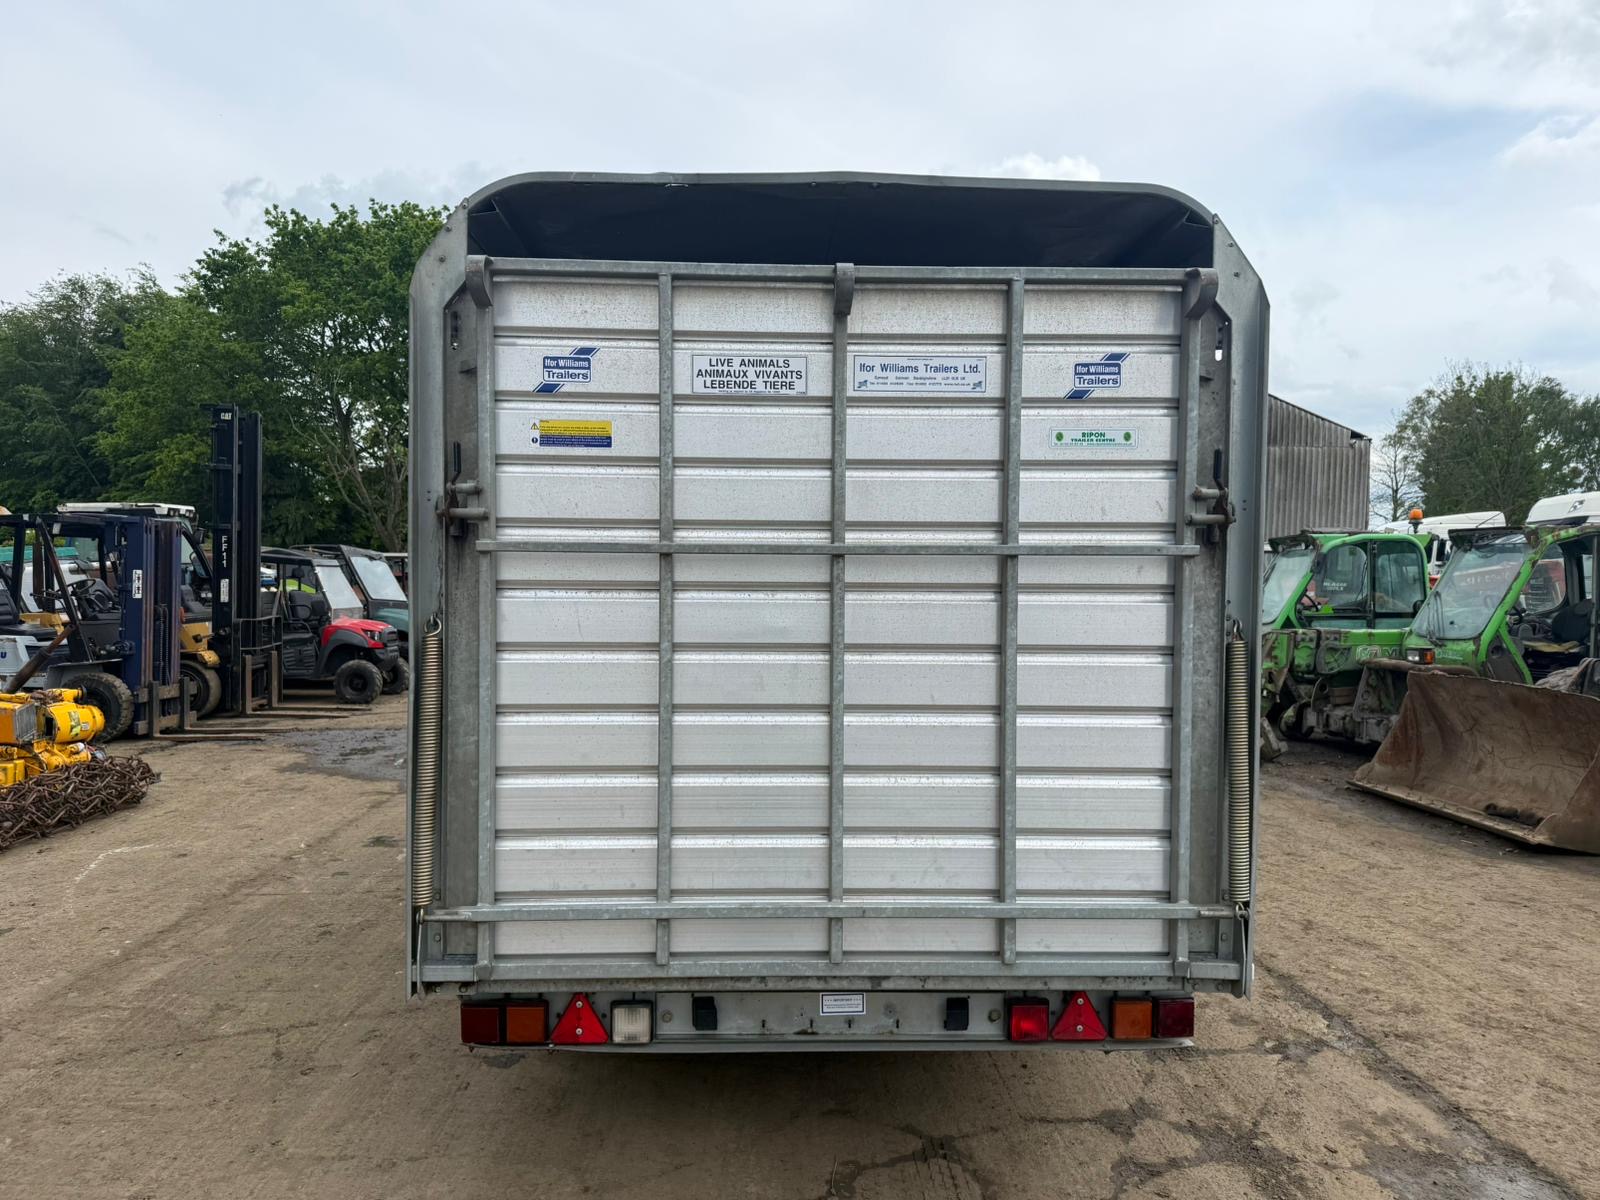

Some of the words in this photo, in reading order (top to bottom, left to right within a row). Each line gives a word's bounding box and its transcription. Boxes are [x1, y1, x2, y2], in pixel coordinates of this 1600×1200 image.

[545, 358, 557, 367] Ifor
[558, 359, 589, 367] Williams
[709, 358, 734, 367] LIVE
[739, 358, 790, 368] ANIMALS
[860, 363, 875, 372] Ifor
[880, 363, 919, 373] Williams
[923, 364, 958, 373] Trailers
[963, 364, 981, 374] Ltd.
[1076, 365, 1088, 373] Ifor
[1089, 365, 1118, 373] Williams
[545, 370, 589, 380] Trailers
[696, 369, 748, 379] ANIMAUX
[754, 369, 803, 380] VIVANTS
[703, 379, 757, 389] LEBENDE
[762, 380, 795, 390] TIERE
[1076, 376, 1118, 386] Trailers
